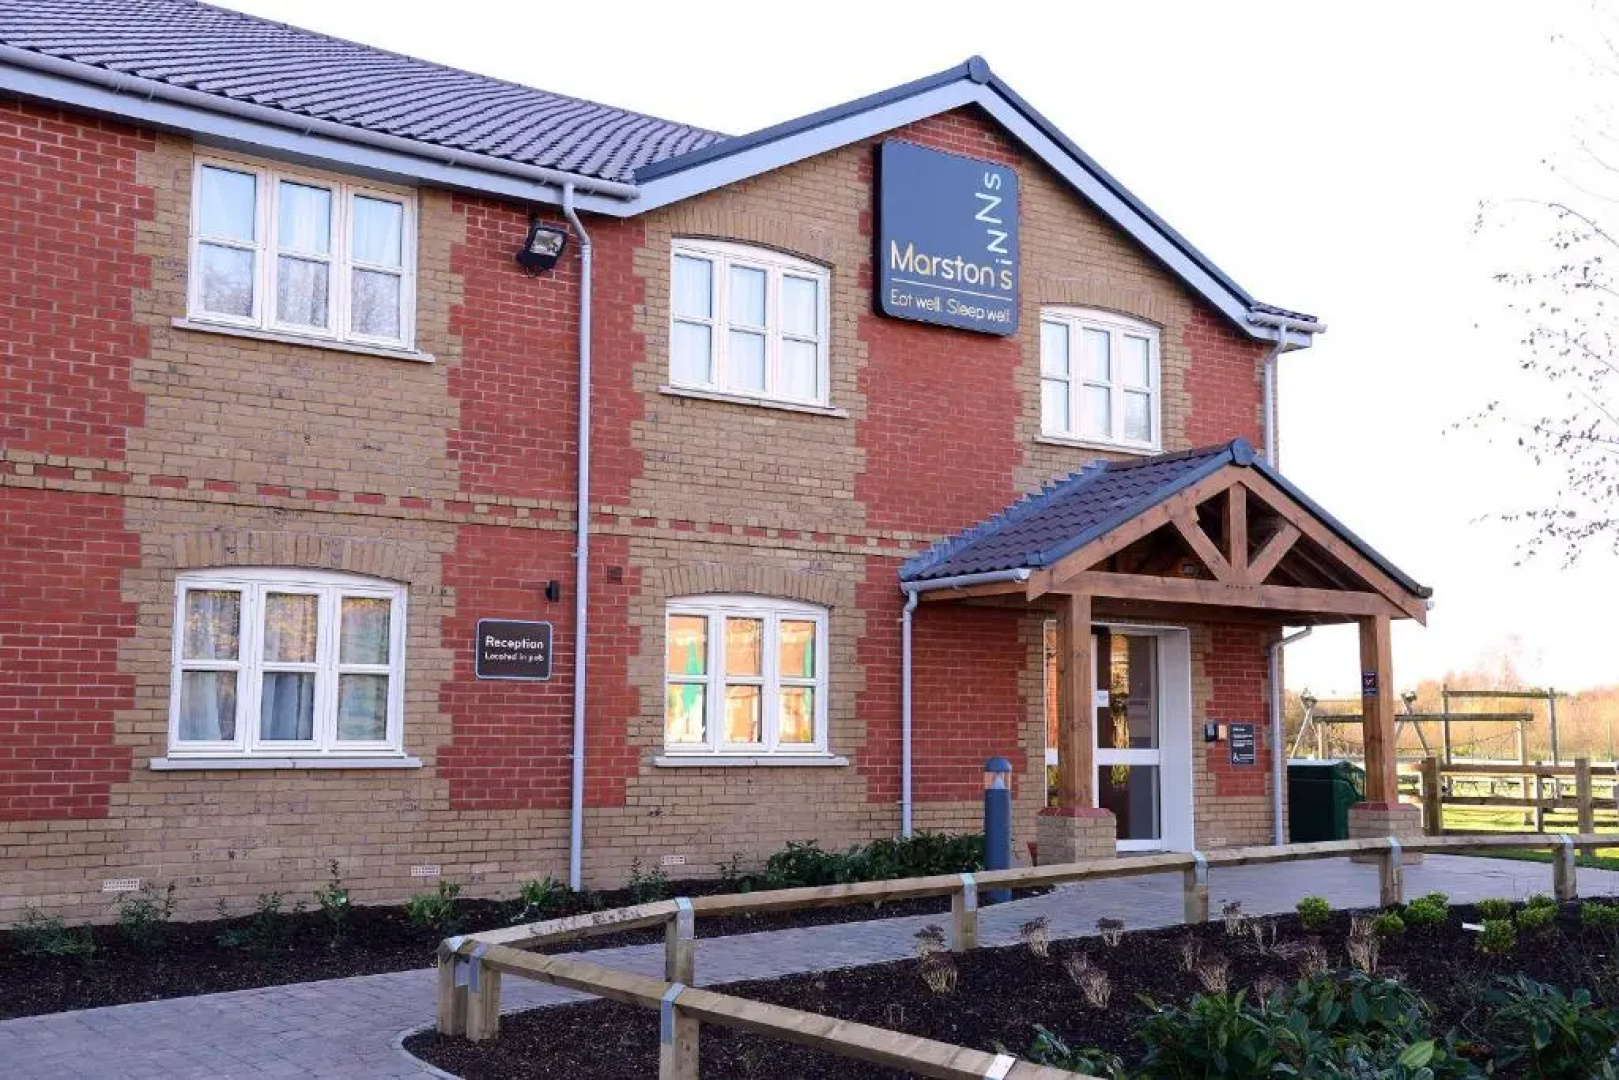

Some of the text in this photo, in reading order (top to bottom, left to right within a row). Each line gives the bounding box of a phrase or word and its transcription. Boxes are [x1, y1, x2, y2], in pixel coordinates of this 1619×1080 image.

[891, 288, 913, 307] Eat
[946, 298, 984, 319] Sleep
[485, 635, 544, 650] Reception
[485, 651, 517, 660] Located
[529, 654, 544, 663] pub
